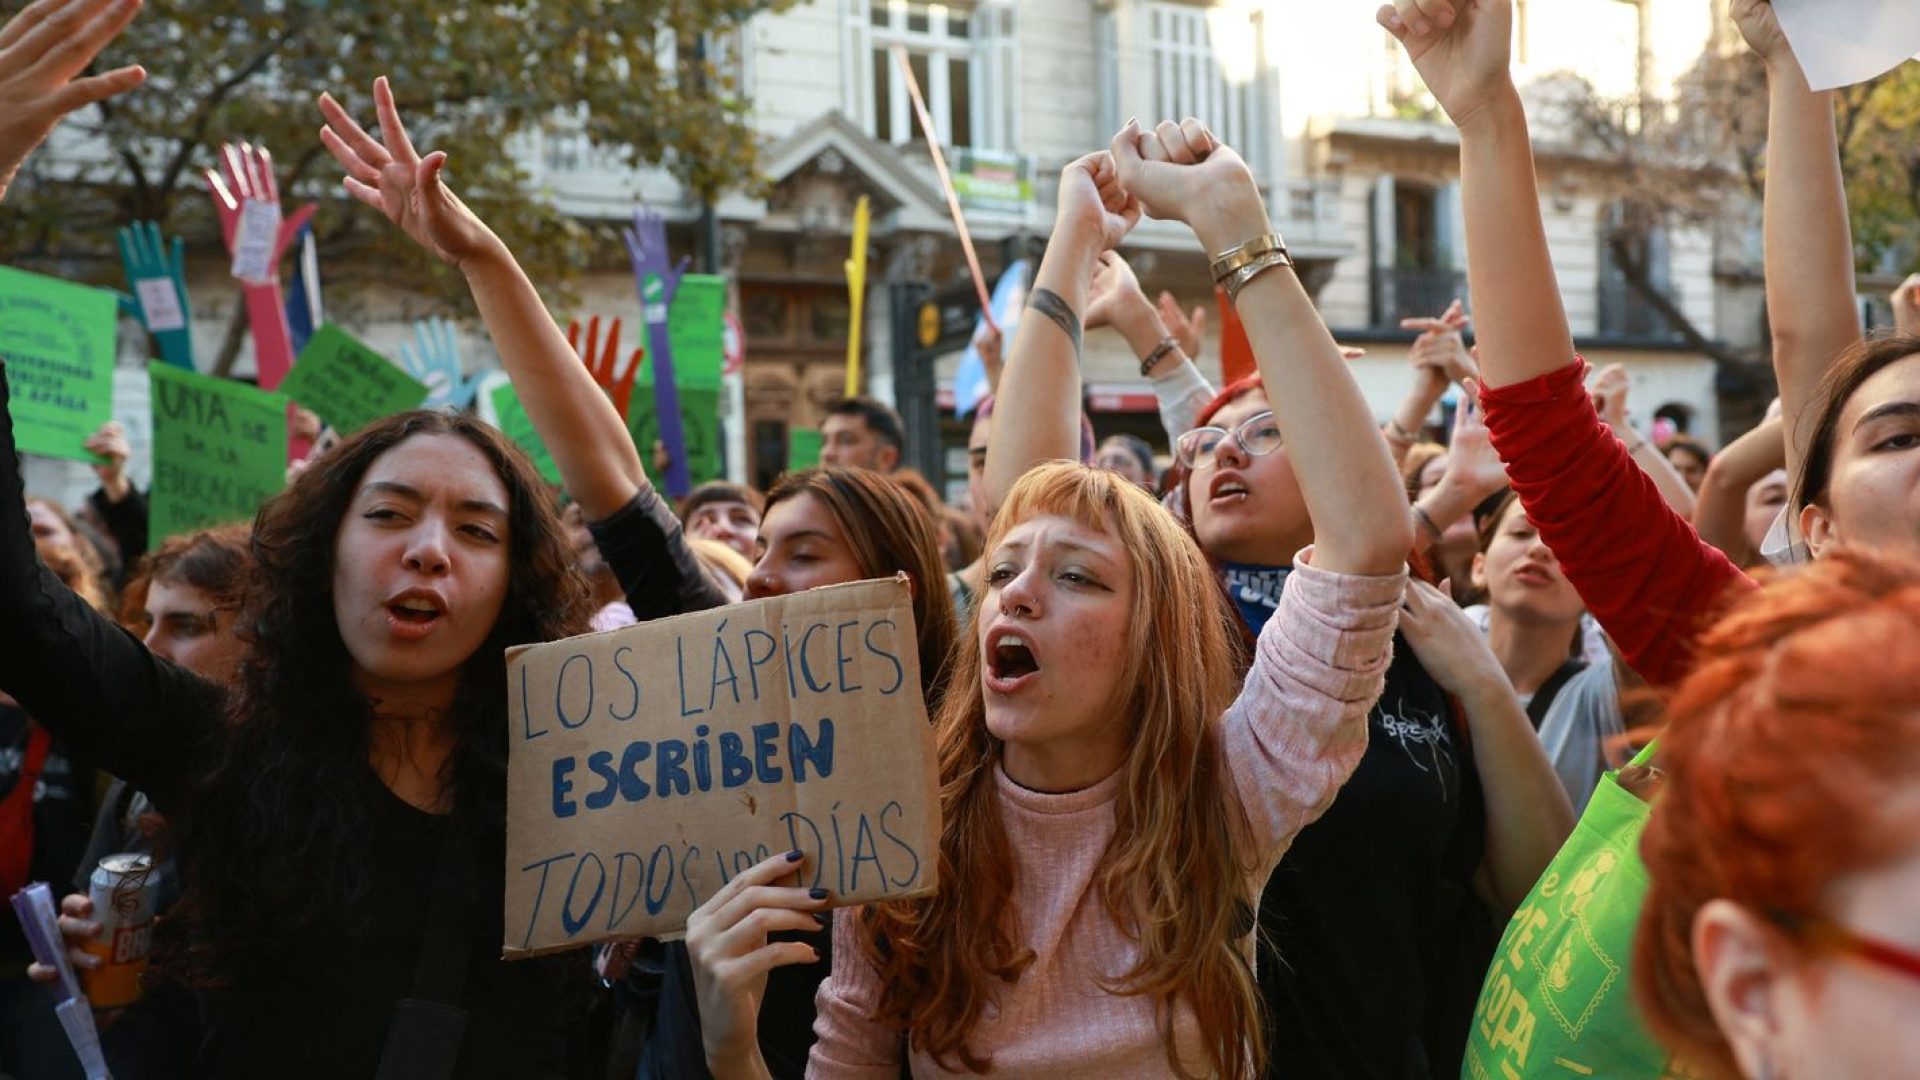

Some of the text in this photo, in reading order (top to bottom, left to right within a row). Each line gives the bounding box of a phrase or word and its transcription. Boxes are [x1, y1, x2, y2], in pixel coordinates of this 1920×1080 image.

[521, 617, 904, 740] LOS LÁPICES
[551, 717, 835, 819] ESCRIBEN
[521, 843, 700, 948] TODOS
[780, 801, 920, 896] DÍAS
